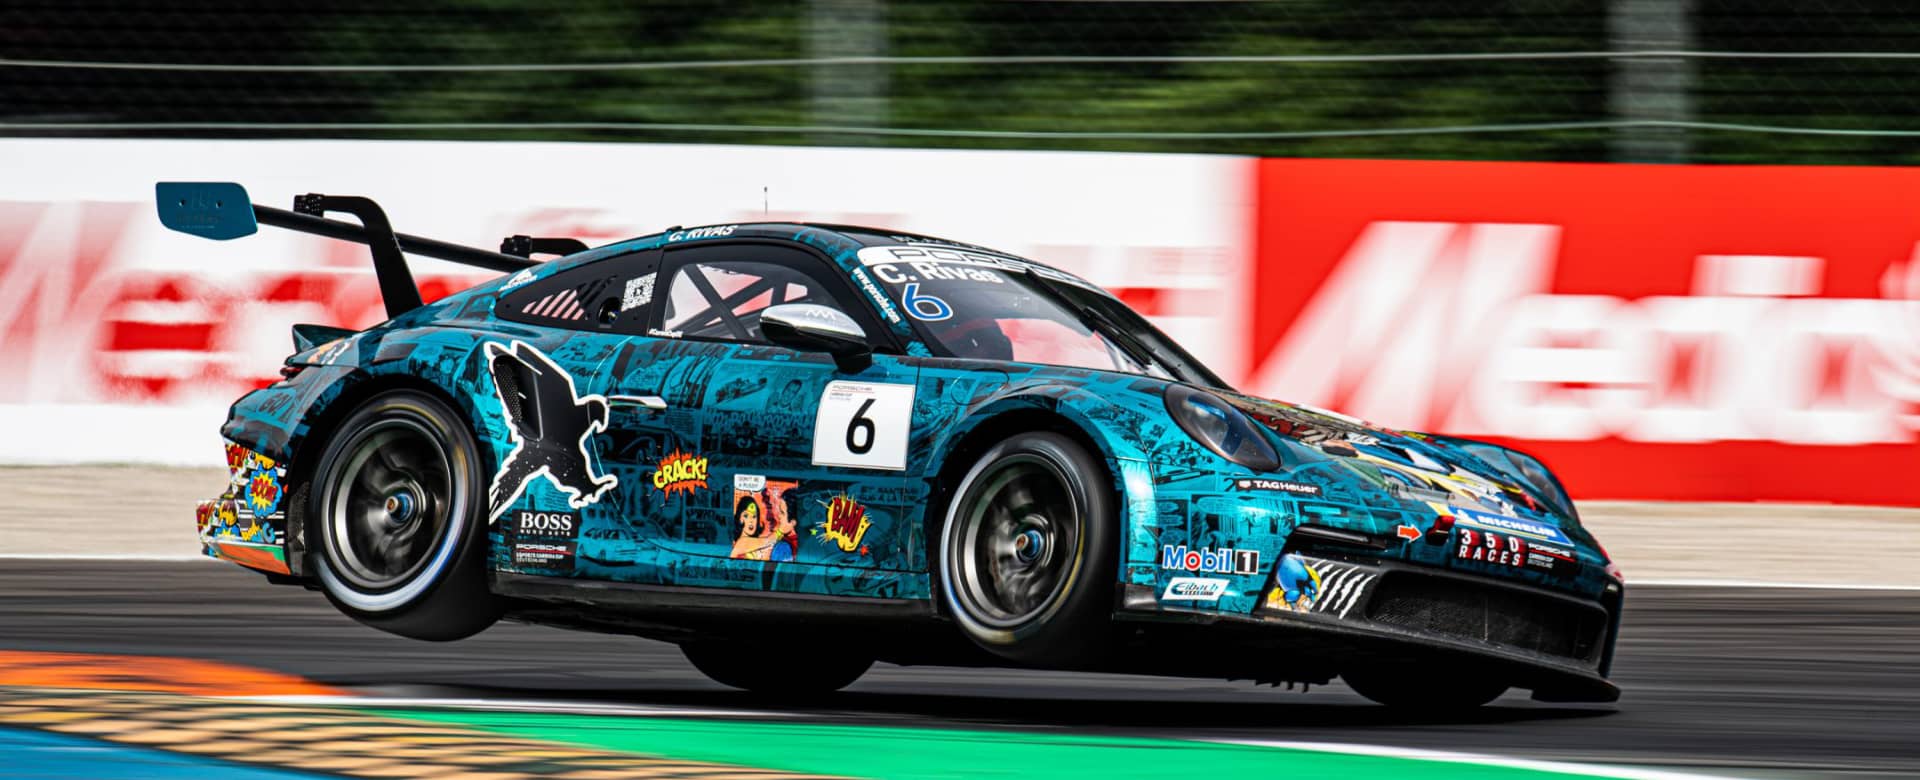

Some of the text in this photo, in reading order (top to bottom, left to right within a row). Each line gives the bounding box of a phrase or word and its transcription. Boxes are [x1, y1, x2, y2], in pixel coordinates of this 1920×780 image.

[873, 260, 1003, 284] C. Rivas
[902, 282, 953, 321] 6
[845, 397, 877, 456] 6
[653, 457, 708, 489] CRACK!
[520, 511, 573, 531] BOSS
[1476, 514, 1558, 538] MICHELIN
[515, 543, 568, 552] PORSCHE
[1162, 545, 1233, 574] Mobil
[1458, 544, 1522, 567] RACES
